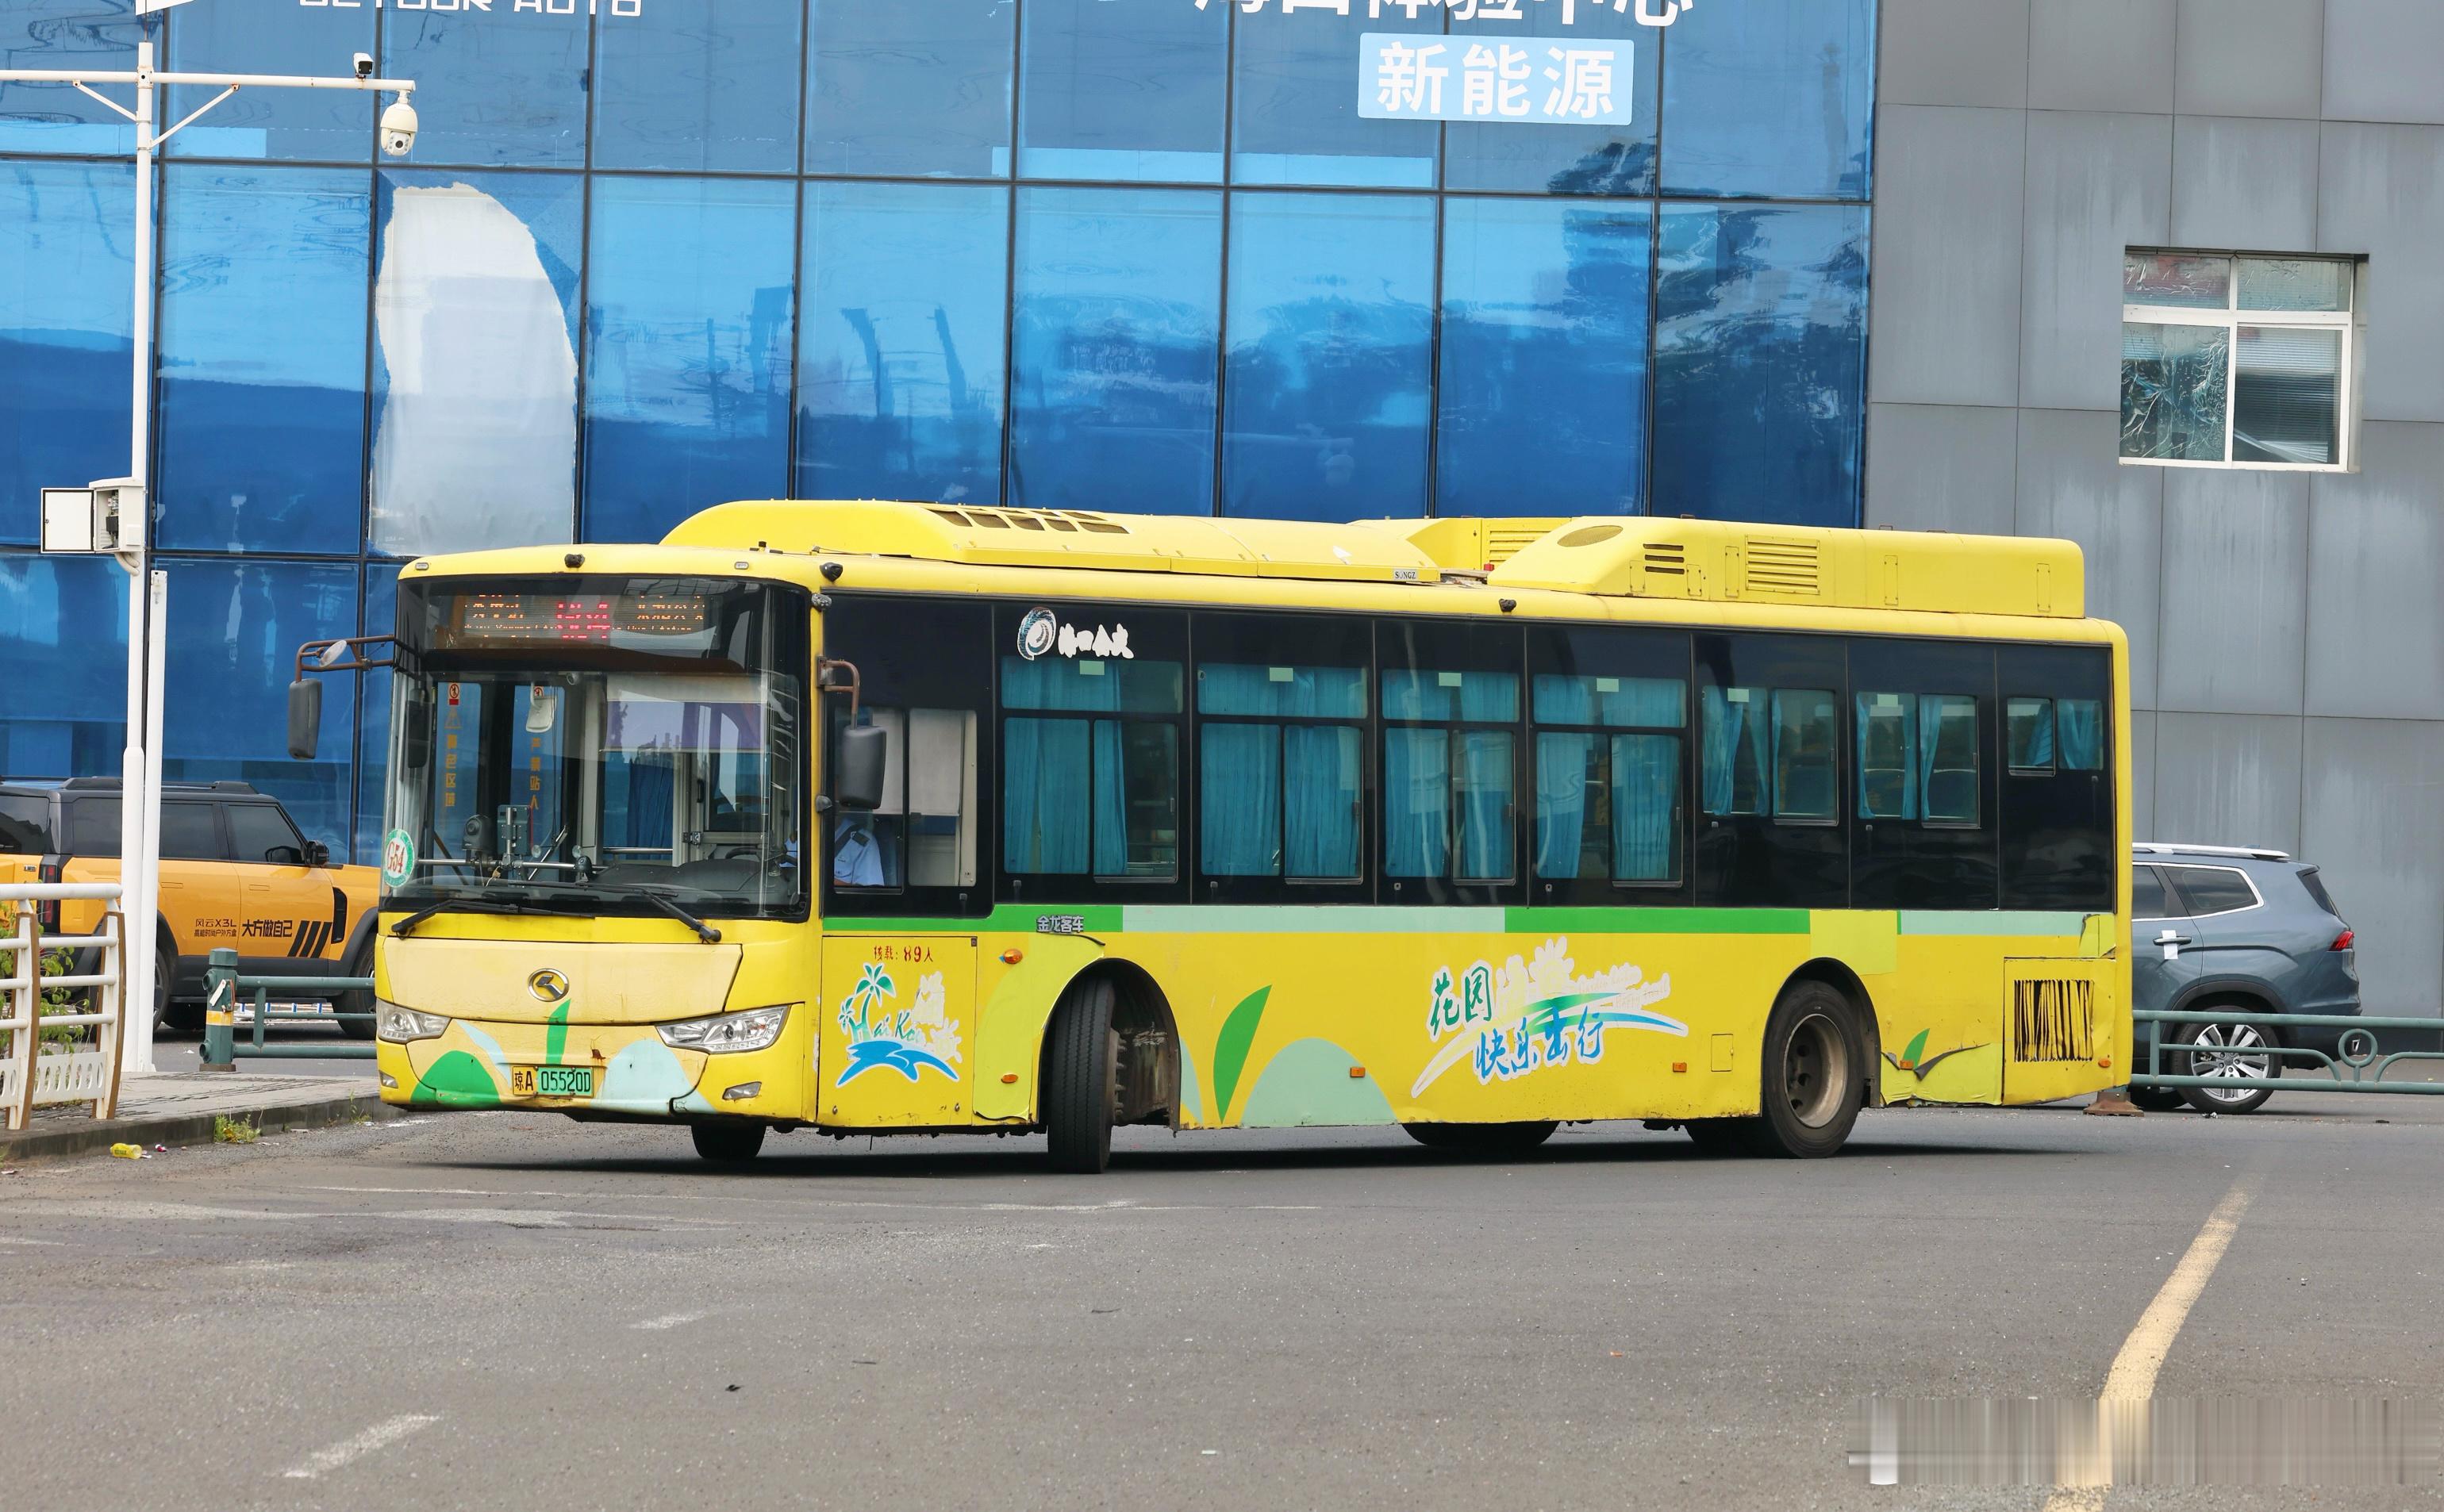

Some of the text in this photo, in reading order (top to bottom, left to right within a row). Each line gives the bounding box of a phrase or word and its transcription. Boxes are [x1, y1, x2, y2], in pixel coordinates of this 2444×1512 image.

[1377, 41, 1615, 118] 新能源
[241, 919, 293, 938] 大方做自己
[1037, 915, 1085, 933] 金龙客车
[1476, 1005, 1604, 1080] 快乐出行
[540, 1071, 591, 1092] 05520D
